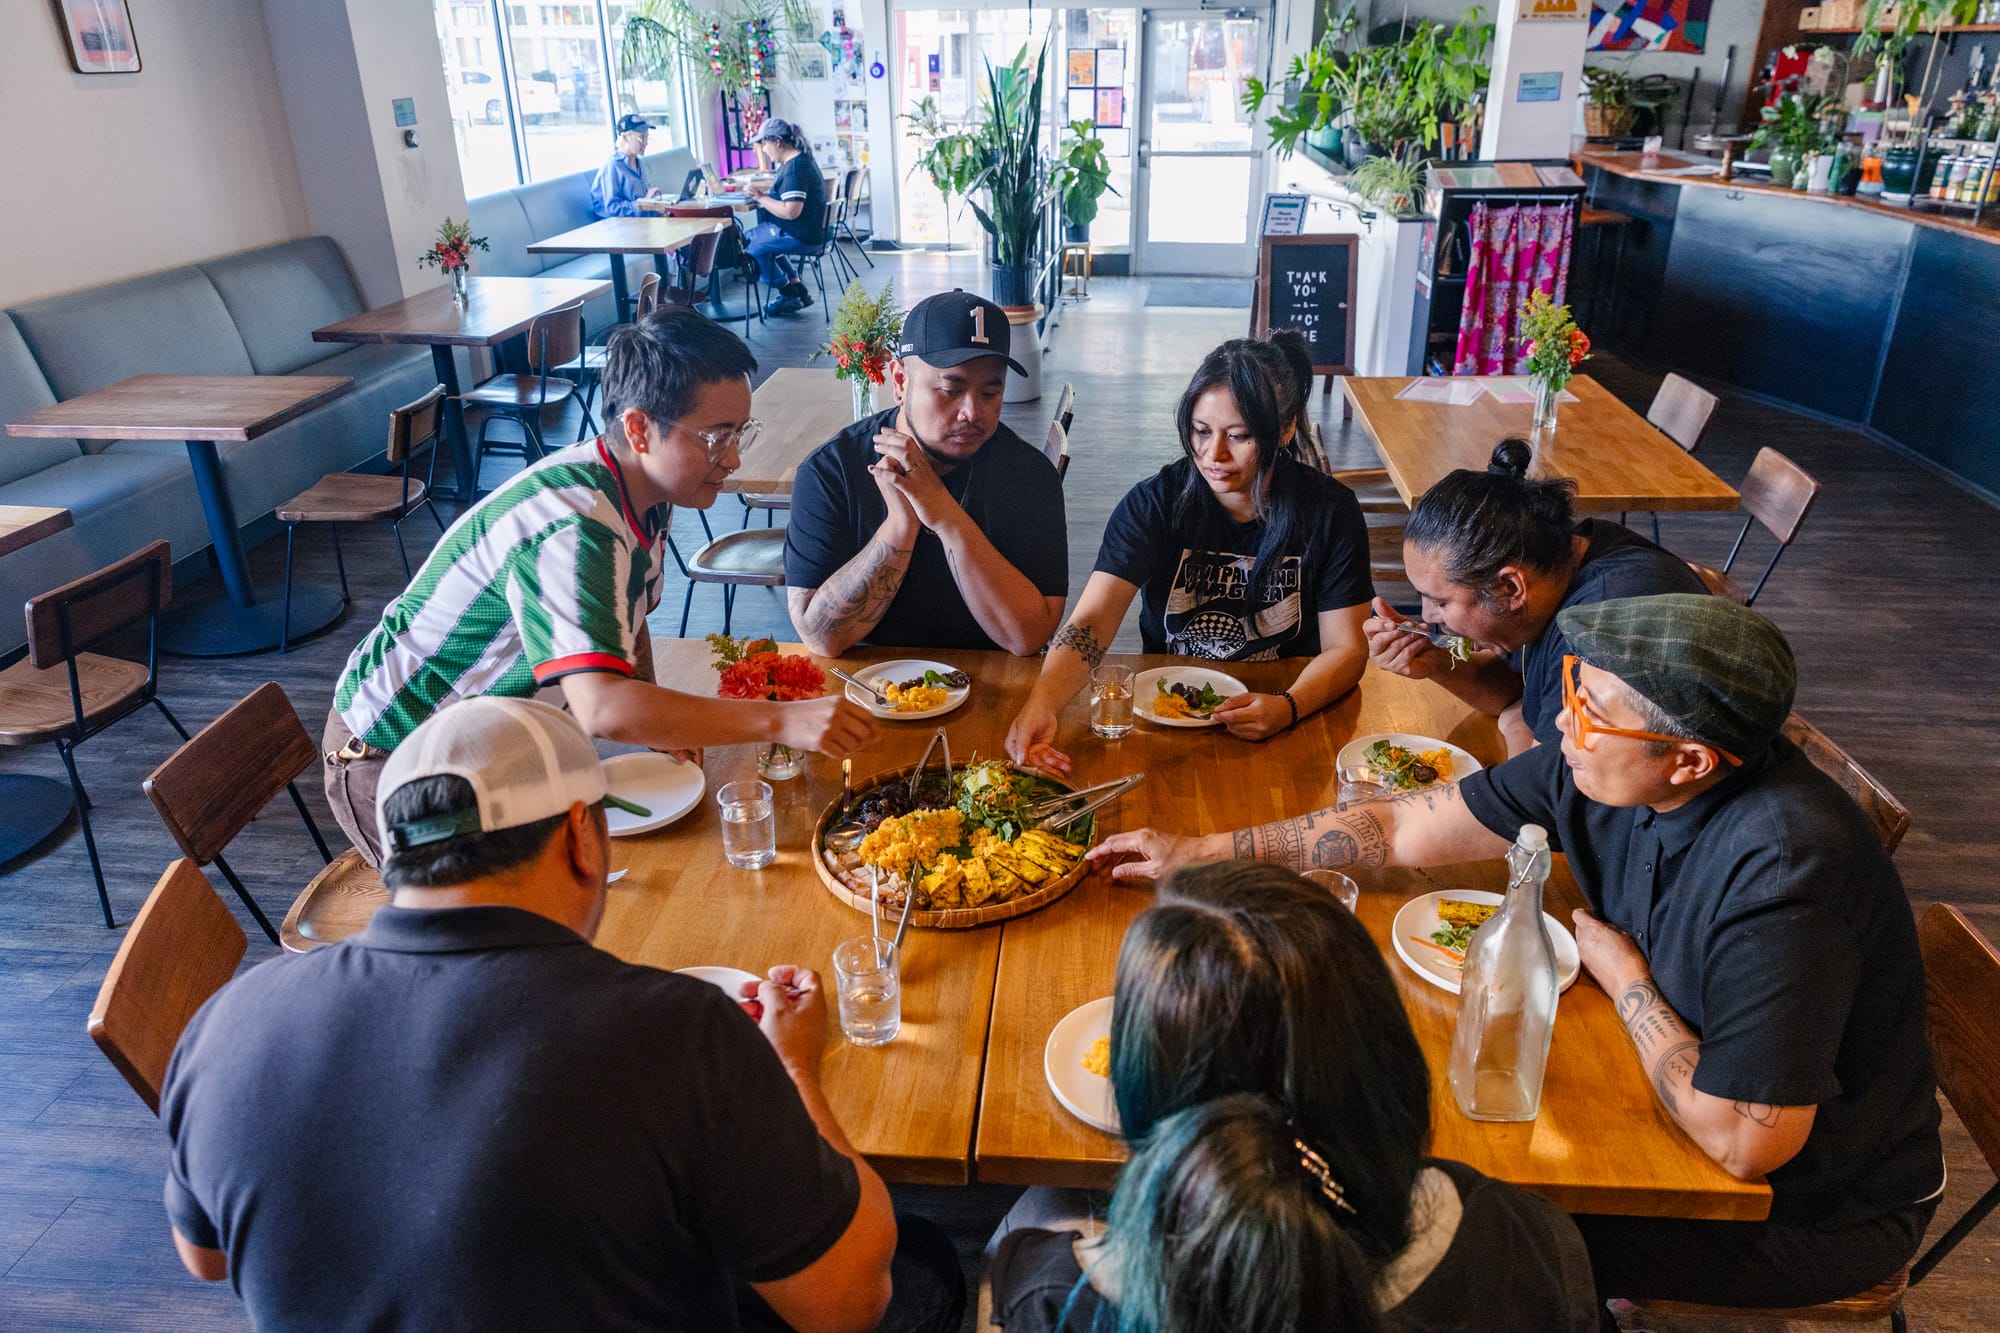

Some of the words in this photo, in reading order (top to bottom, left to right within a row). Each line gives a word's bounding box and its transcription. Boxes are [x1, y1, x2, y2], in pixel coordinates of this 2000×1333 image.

[1286, 271, 1327, 283] THANK
[1293, 285, 1317, 297] YOU
[969, 305, 990, 345] 1
